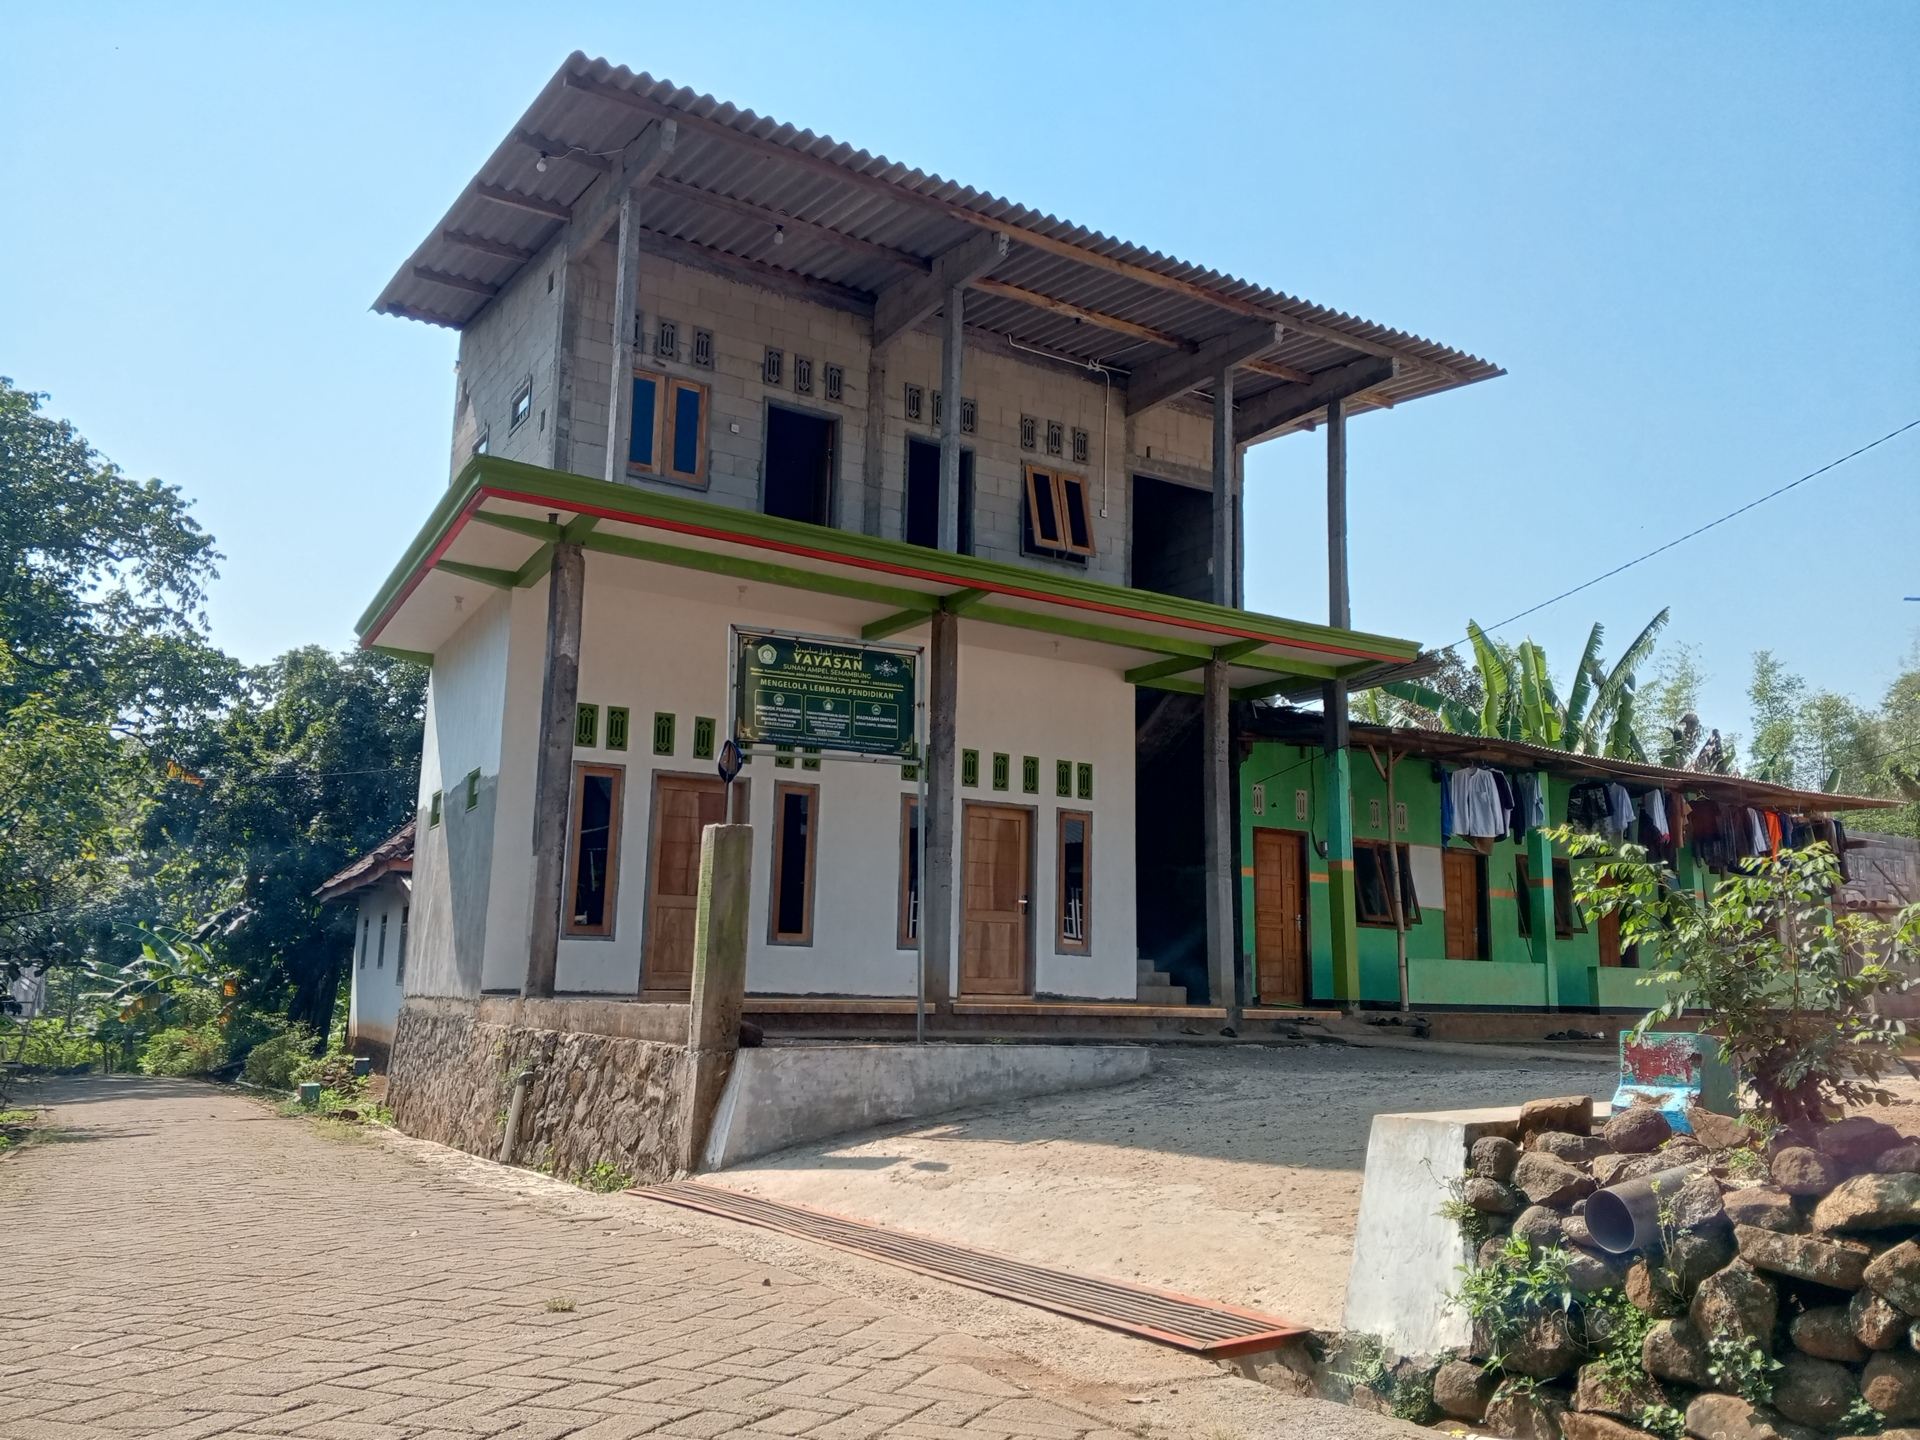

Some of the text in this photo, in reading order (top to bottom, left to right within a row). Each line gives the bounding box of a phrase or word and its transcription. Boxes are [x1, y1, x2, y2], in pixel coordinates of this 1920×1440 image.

[794, 652, 863, 670] YAYASAN
[807, 666, 829, 674] AMPEL
[830, 669, 872, 680] SEMAMBUNG
[760, 678, 894, 700] MENGELOLA LEMBAGA PENDIDIKAN
